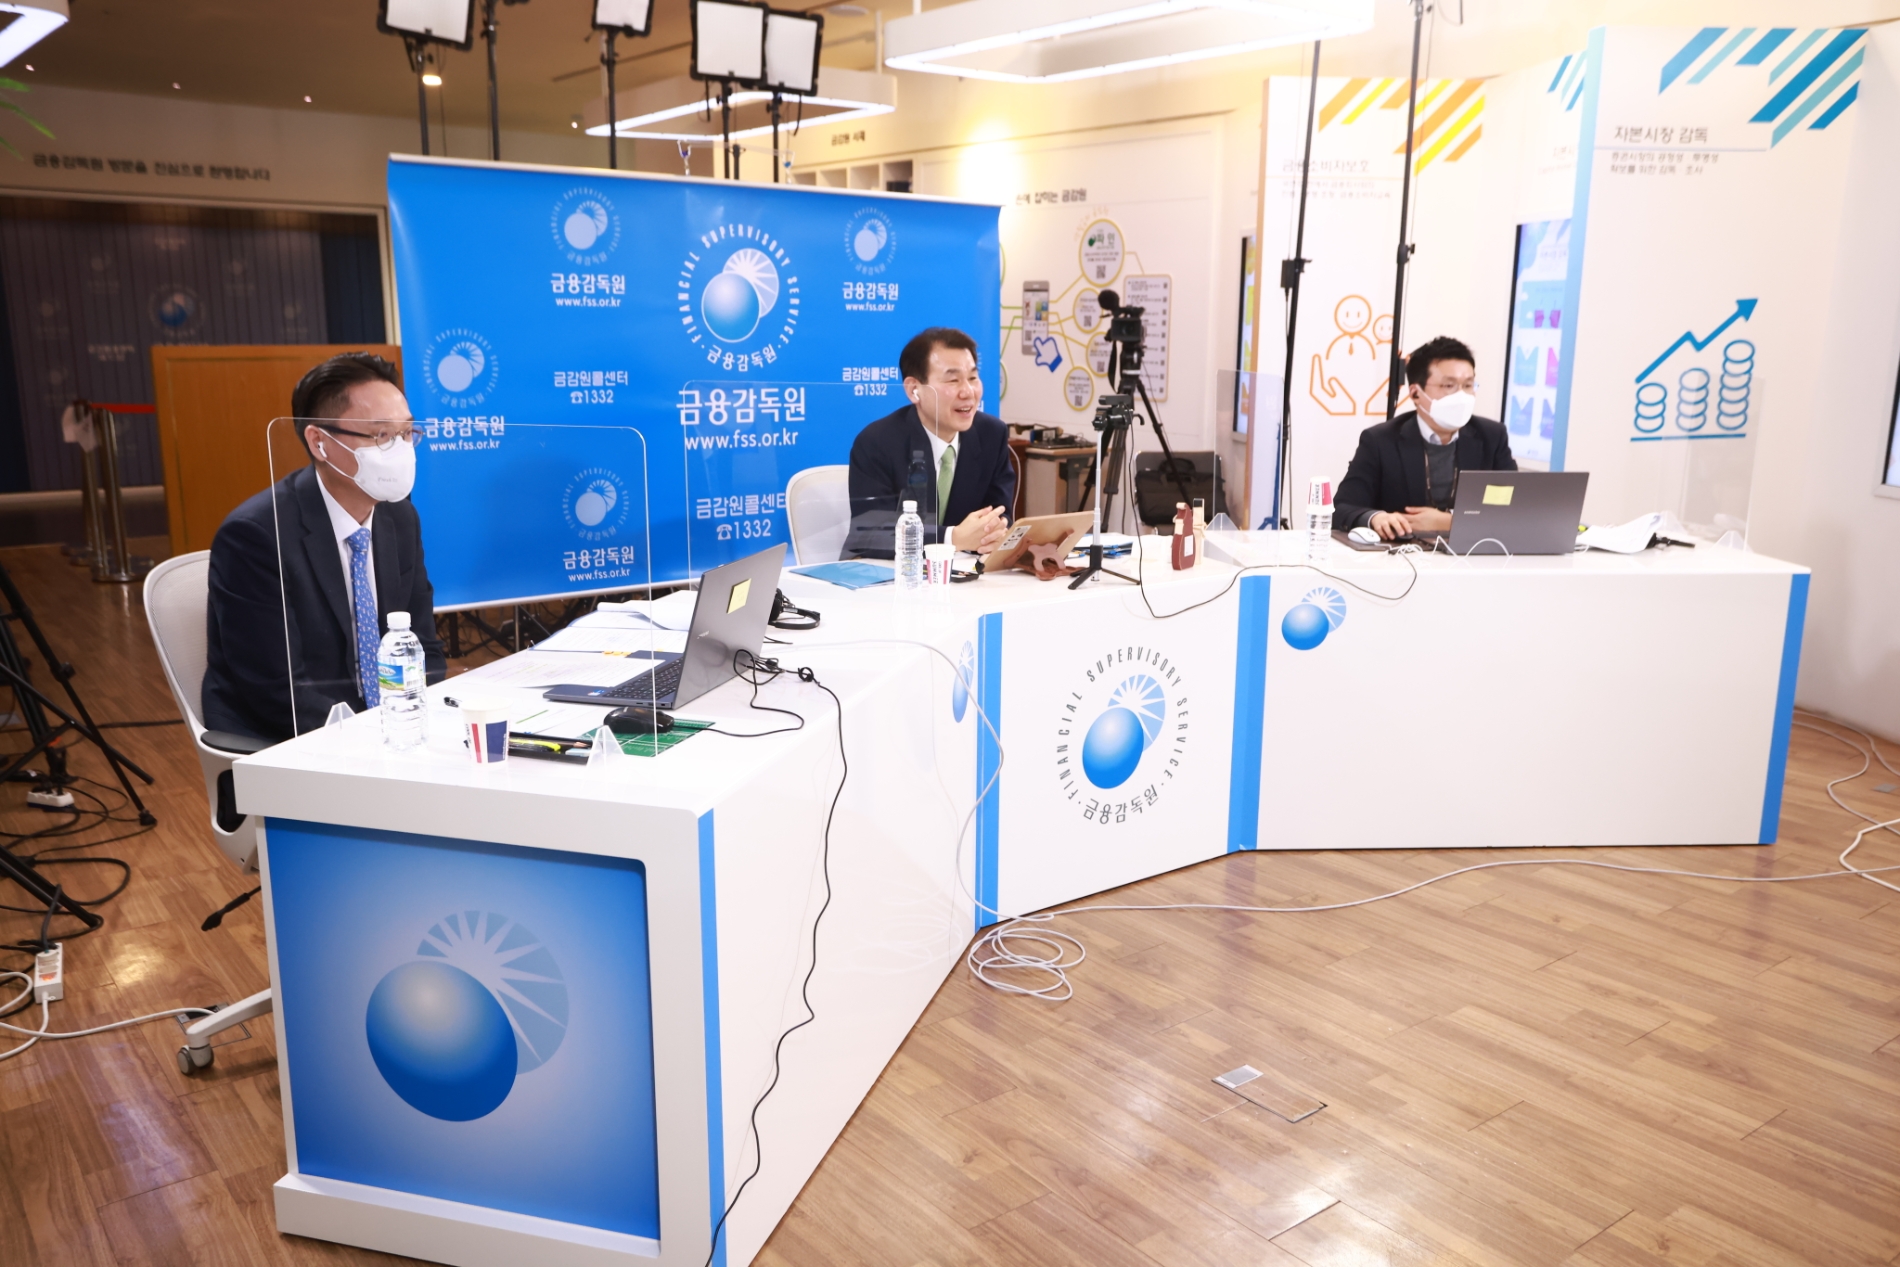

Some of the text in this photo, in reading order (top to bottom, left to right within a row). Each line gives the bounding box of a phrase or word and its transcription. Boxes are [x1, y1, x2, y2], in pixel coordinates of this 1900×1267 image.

[1614, 126, 1708, 144] 자본시장 감독
[550, 272, 626, 295] 금융감독원
[678, 251, 702, 344] FINANCIAL
[701, 223, 791, 268] SUPERVISORY
[779, 275, 801, 344] SERVICE
[842, 281, 899, 301] 금융감독원
[555, 296, 621, 307] www.fss.or.kr
[845, 302, 895, 312] www.fss.or.kr
[707, 344, 777, 372] 금융감독원
[554, 370, 629, 387] 금감원콜센터
[842, 367, 899, 381] 금감원콜센터
[584, 389, 614, 404] 1332
[864, 383, 887, 396] 1332
[676, 387, 806, 426] 금융감독원
[424, 415, 505, 438] 금융감독원
[429, 439, 500, 452] www.fss.or.kr
[685, 428, 799, 450] www.fss.or.kr
[734, 519, 771, 540] 1332
[563, 546, 634, 570] 금융감독원
[568, 567, 631, 582] www.fss.or.kr
[1057, 646, 1189, 800] FINANCIAL SUPERVISORY SERVICE
[1083, 784, 1159, 825] 금융감독원
